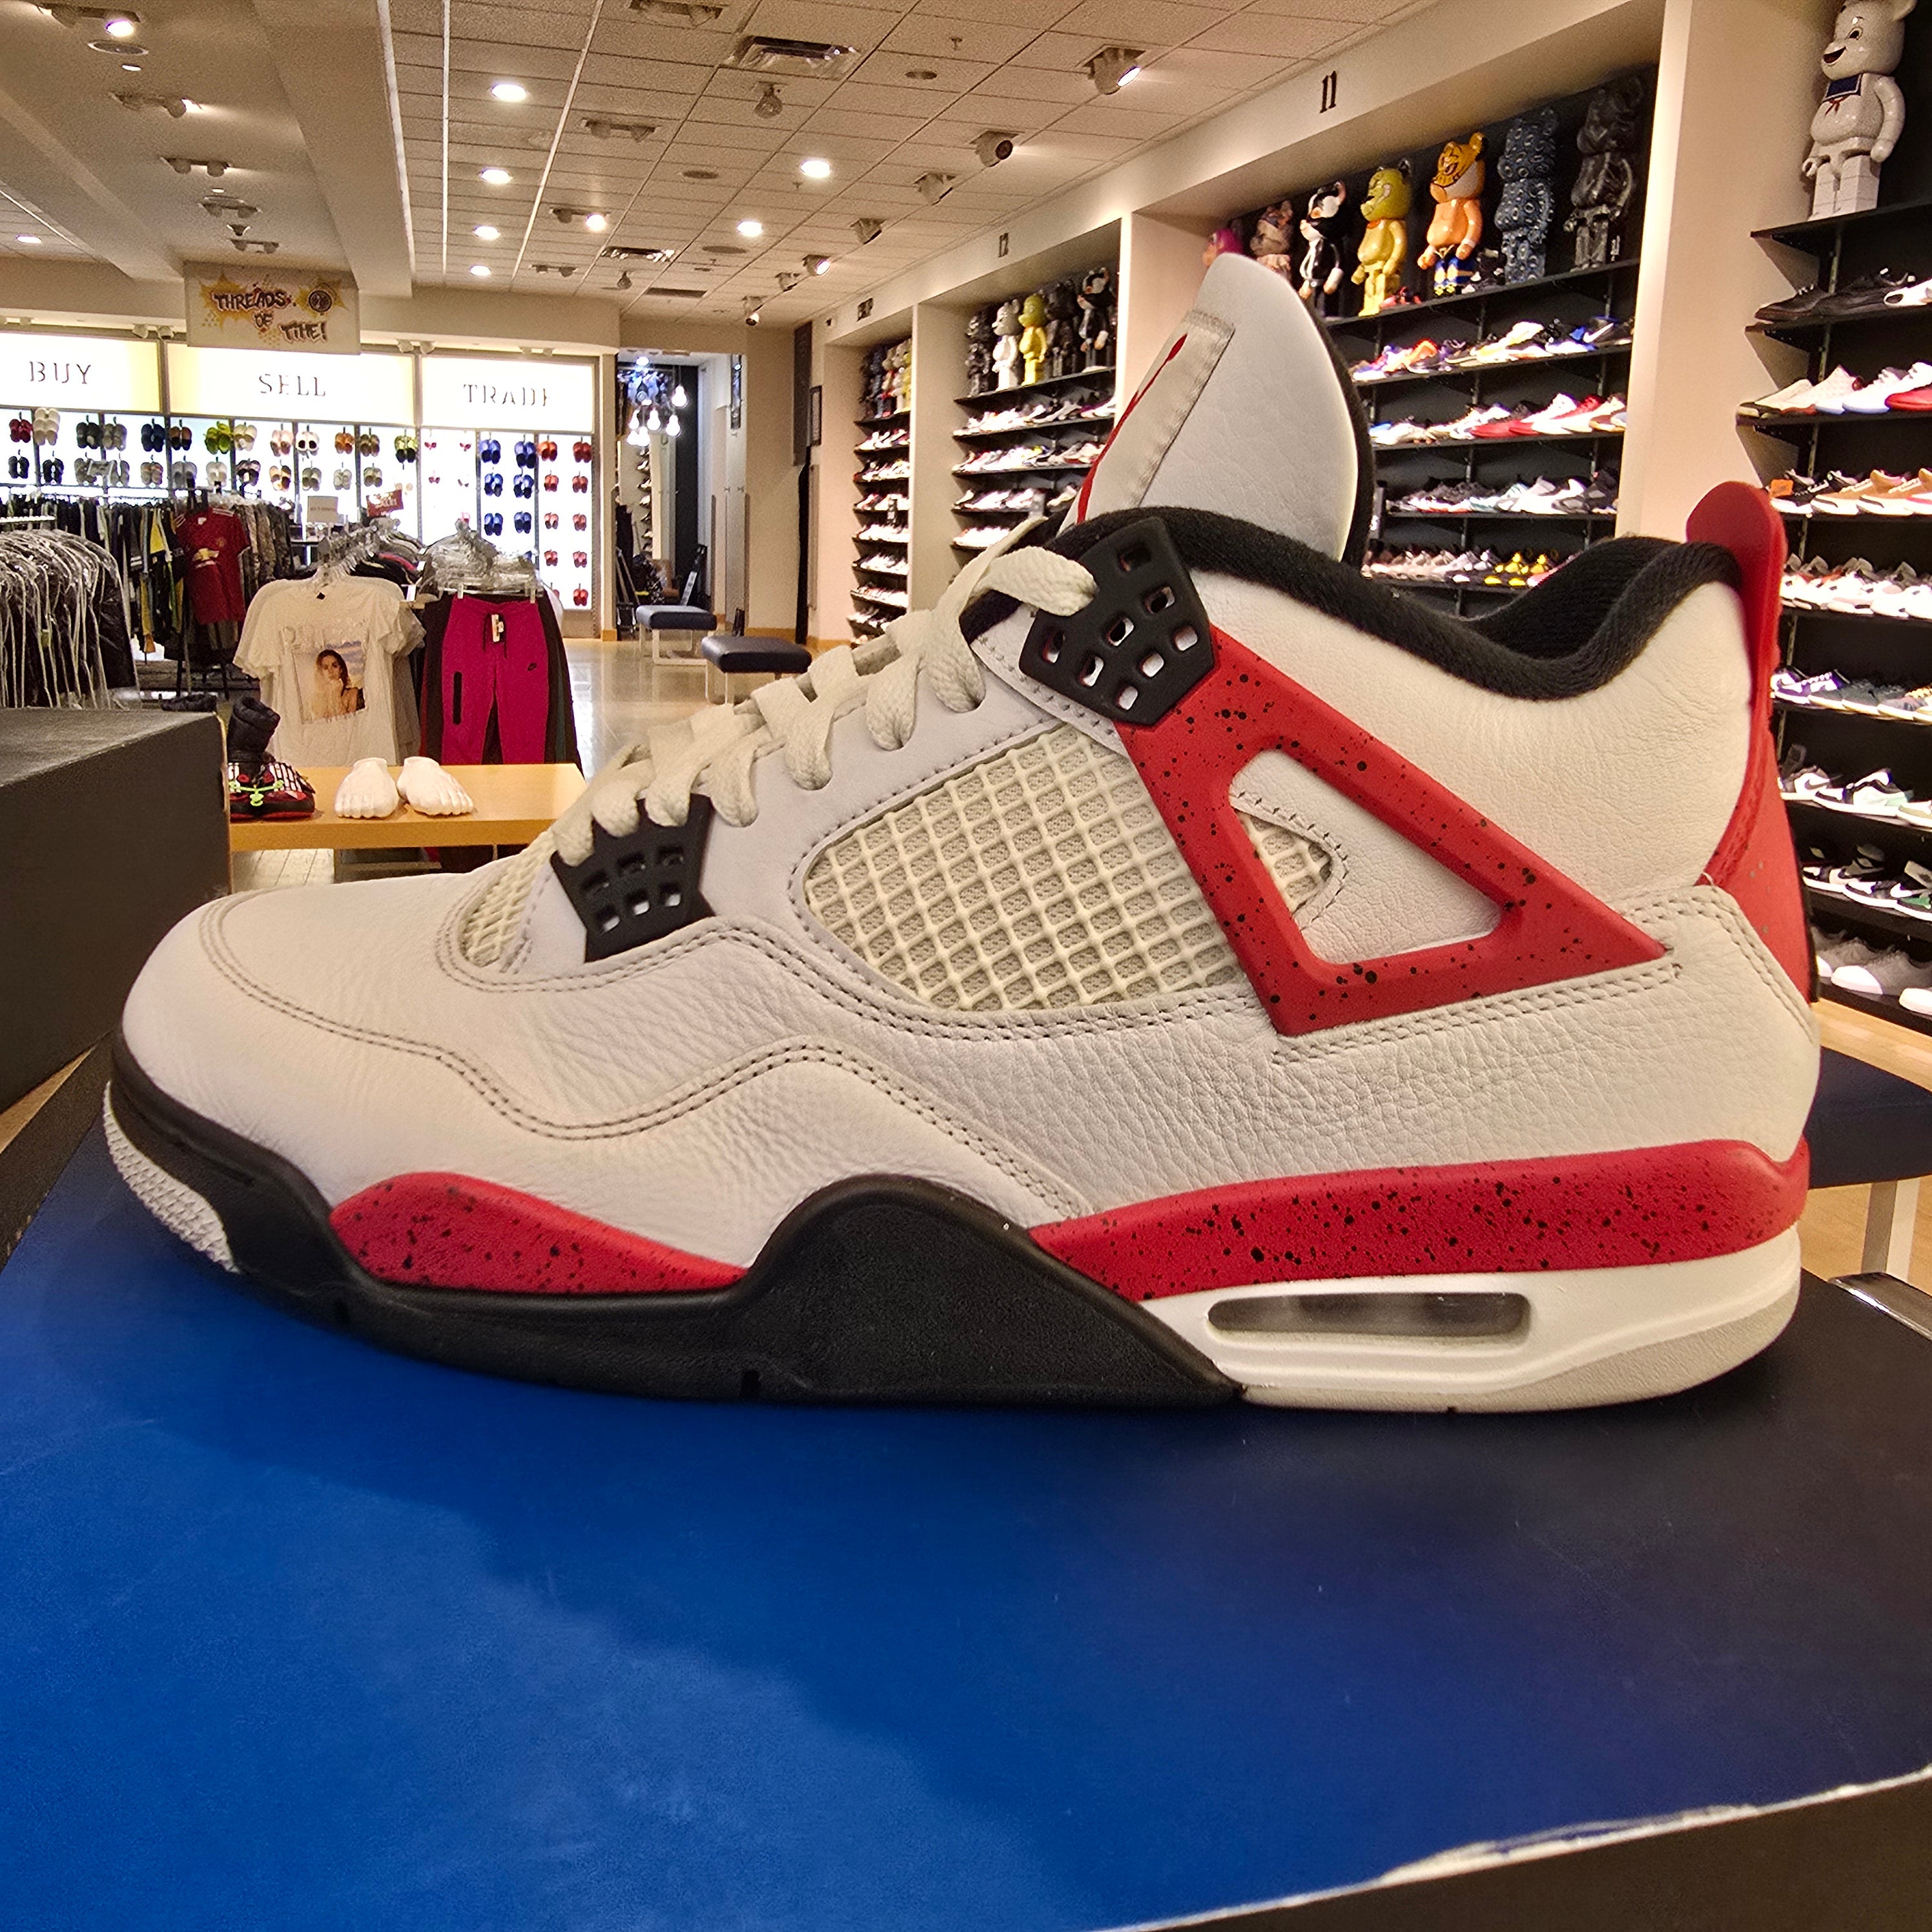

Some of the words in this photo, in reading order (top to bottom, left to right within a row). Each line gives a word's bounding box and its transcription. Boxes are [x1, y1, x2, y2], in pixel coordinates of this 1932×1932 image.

[1319, 70, 1337, 114] 11
[212, 288, 289, 311] THREADS
[254, 313, 274, 328] OF
[29, 361, 92, 384] BUY
[258, 373, 326, 396] SELL
